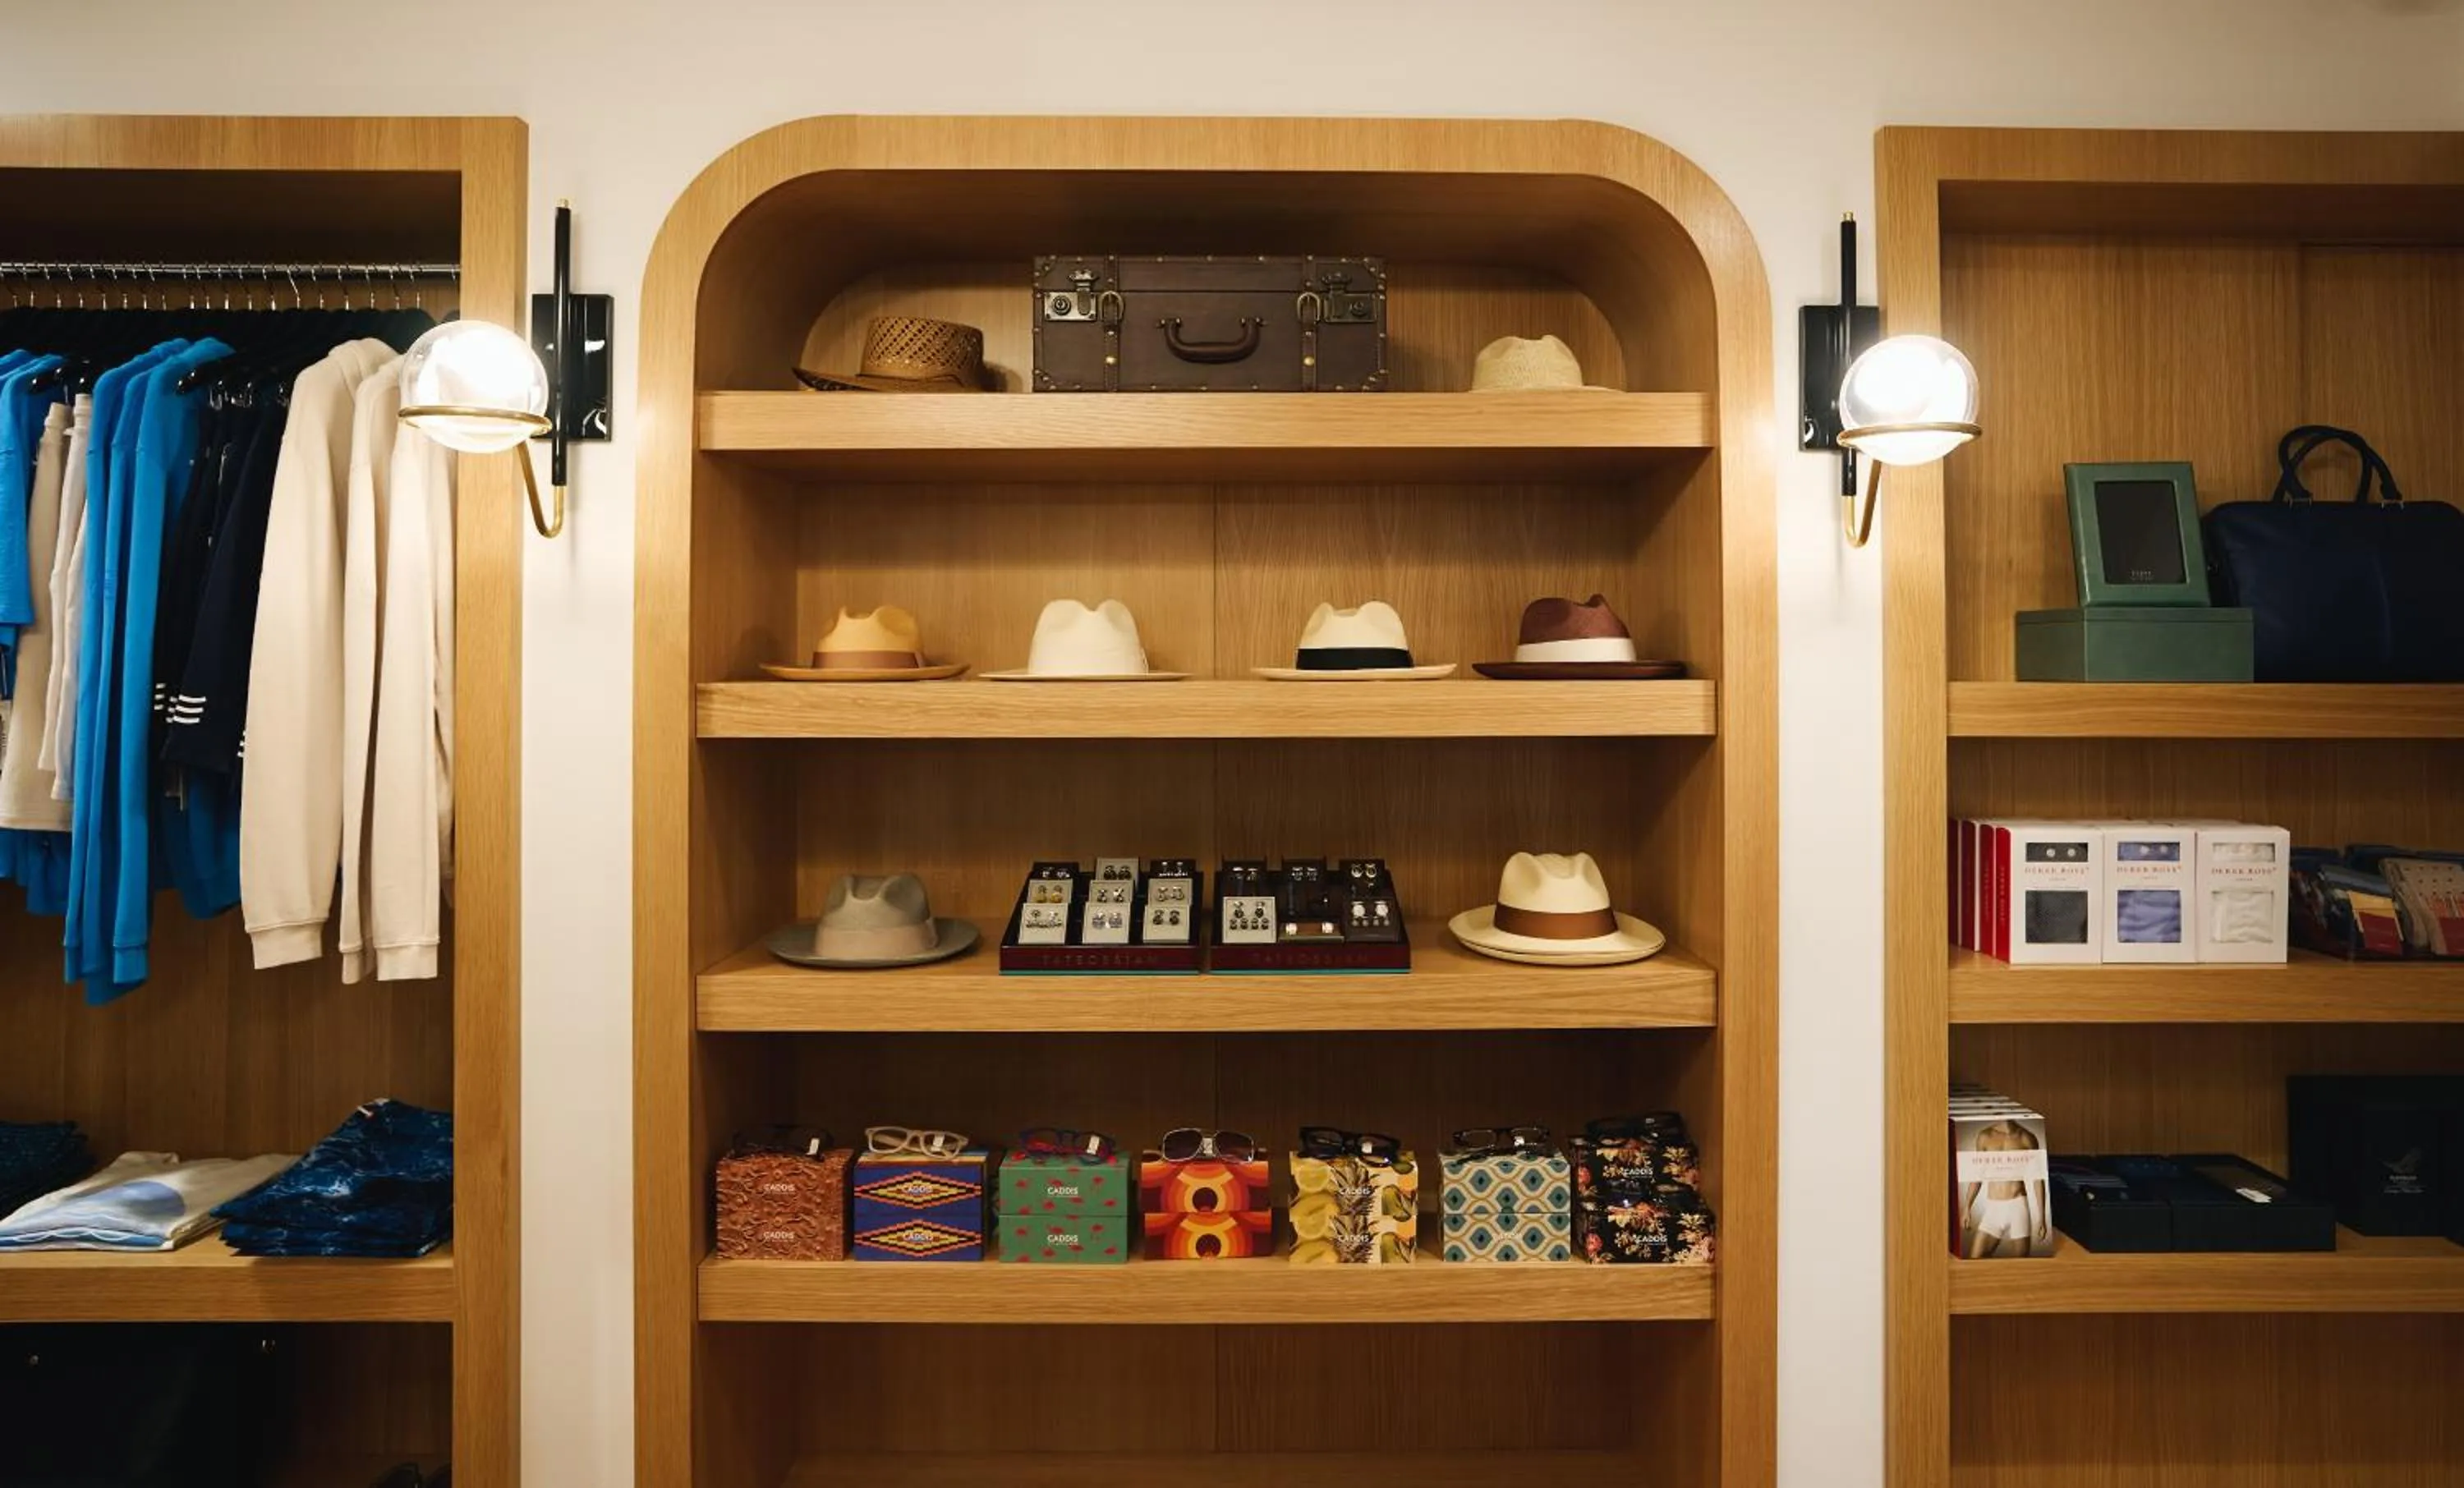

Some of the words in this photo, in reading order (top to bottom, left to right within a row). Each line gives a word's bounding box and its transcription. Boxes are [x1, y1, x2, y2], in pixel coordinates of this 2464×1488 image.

[763, 1183, 796, 1192] CADDIS
[1047, 1187, 1079, 1195] CADDIS
[1047, 1234, 1078, 1242] CADDIS
